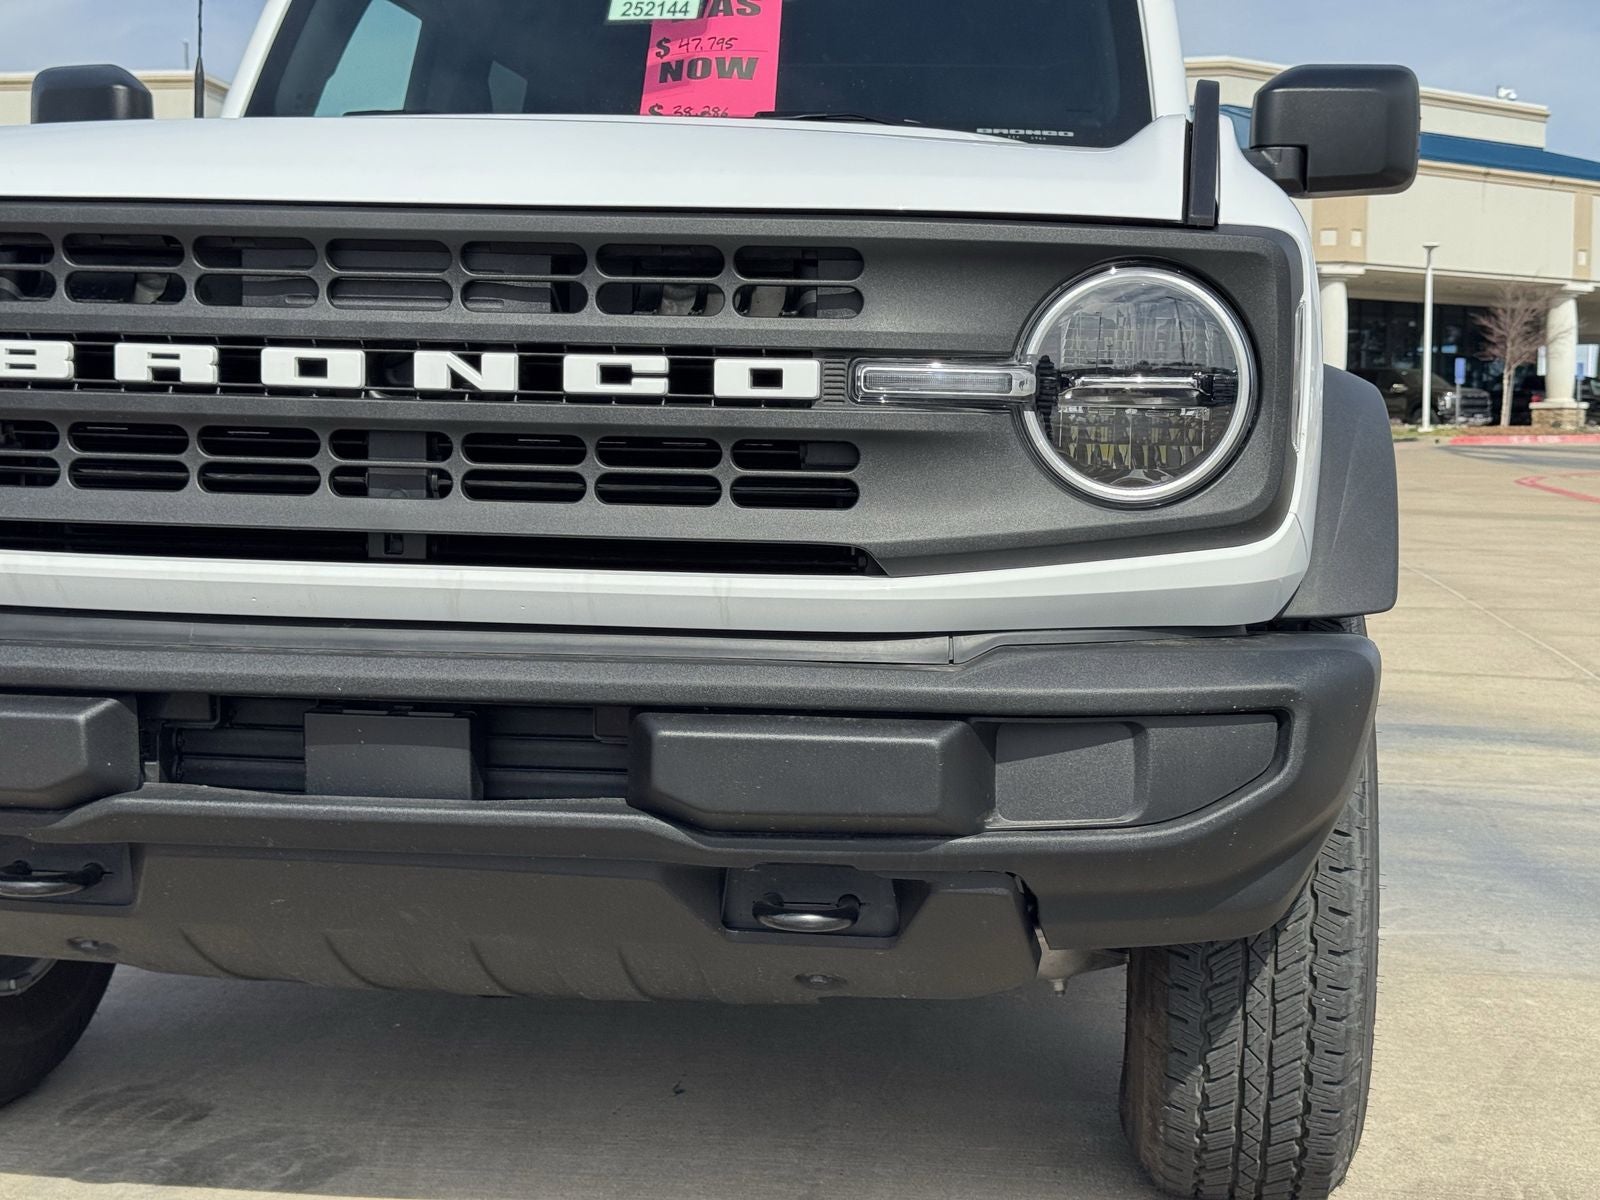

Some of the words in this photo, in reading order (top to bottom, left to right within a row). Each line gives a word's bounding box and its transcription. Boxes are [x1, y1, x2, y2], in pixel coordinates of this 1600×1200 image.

[620, 1, 690, 17] 252144
[658, 56, 759, 84] NOW
[976, 127, 1075, 137] BRONCO
[0, 340, 821, 399] BRONCO
